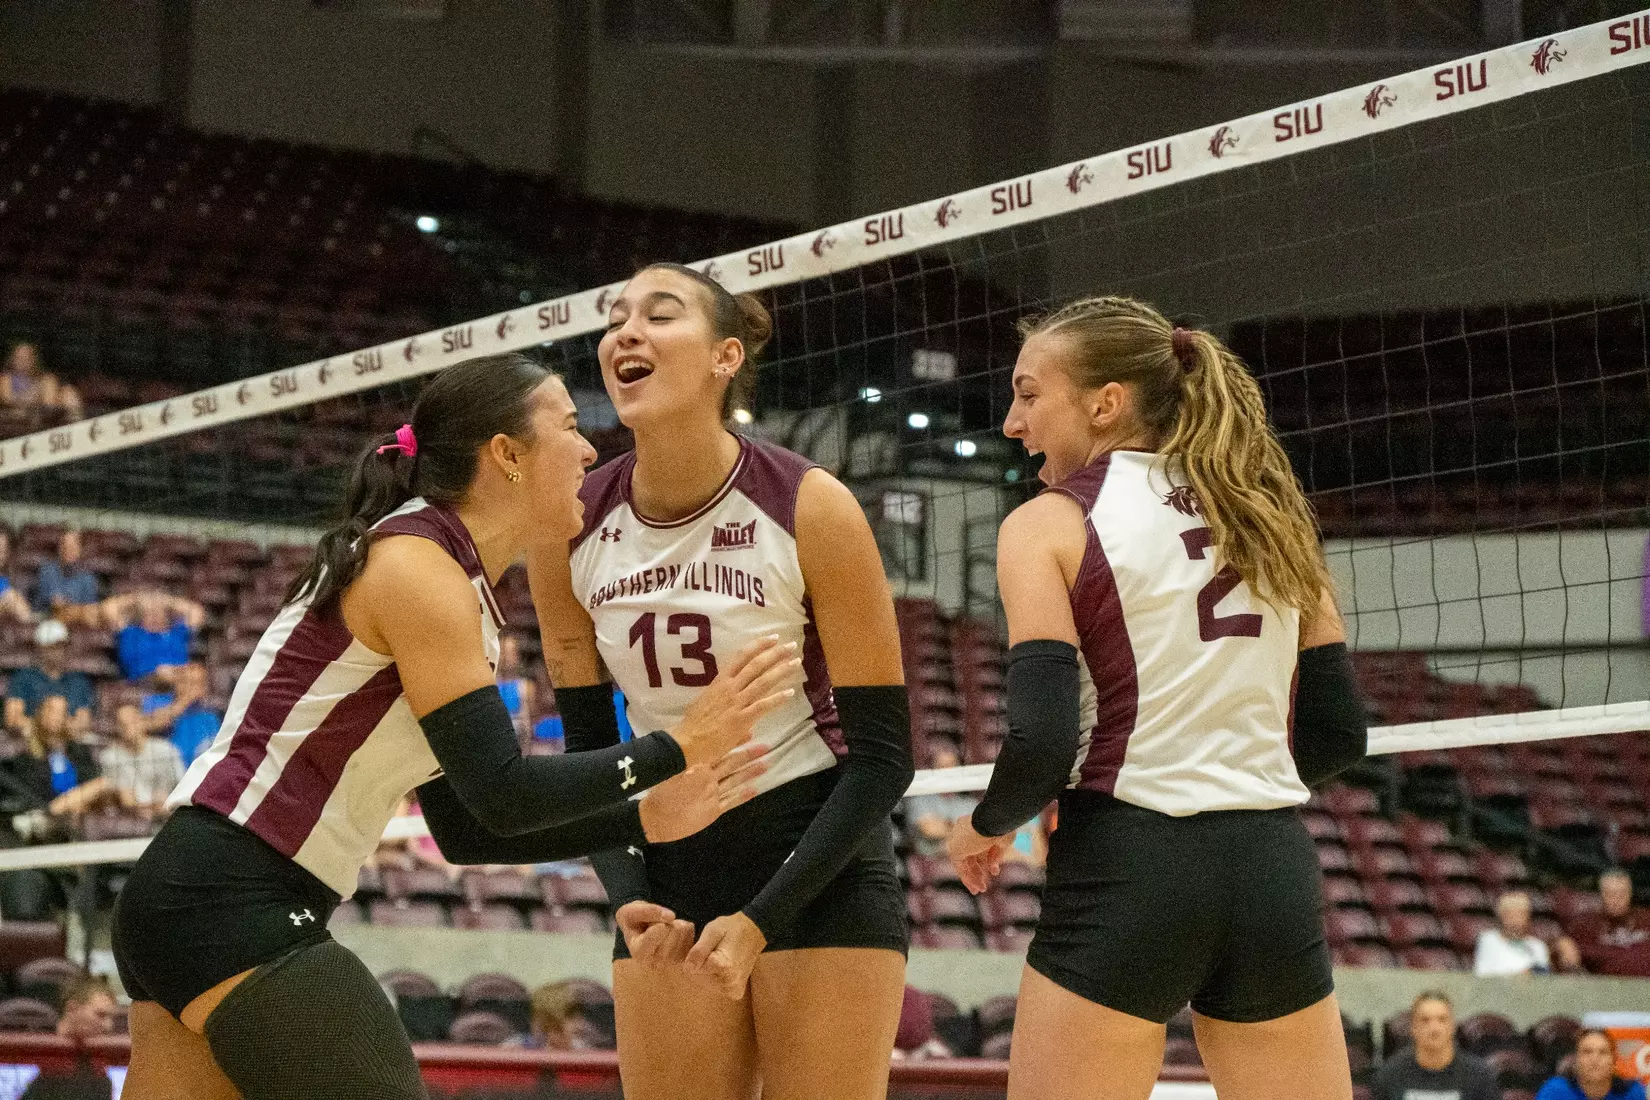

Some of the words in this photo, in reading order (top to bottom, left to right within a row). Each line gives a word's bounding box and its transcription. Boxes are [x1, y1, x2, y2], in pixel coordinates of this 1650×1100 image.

[192, 395, 217, 417] SIU
[270, 372, 297, 396] SIU
[353, 350, 383, 376] SIU
[441, 326, 473, 353] SIU
[538, 301, 570, 331] SIU
[747, 244, 785, 276] SIU
[864, 213, 904, 246] SIU
[991, 180, 1033, 215] SIU
[1127, 143, 1172, 180] SIU
[1273, 103, 1323, 142] SIU
[1434, 59, 1488, 101] SIU
[711, 519, 757, 547] VALLEY
[590, 564, 681, 609] SOUTHERN
[684, 562, 765, 607] ILLINOIS
[1179, 527, 1263, 642] 2
[629, 612, 719, 688] 13
